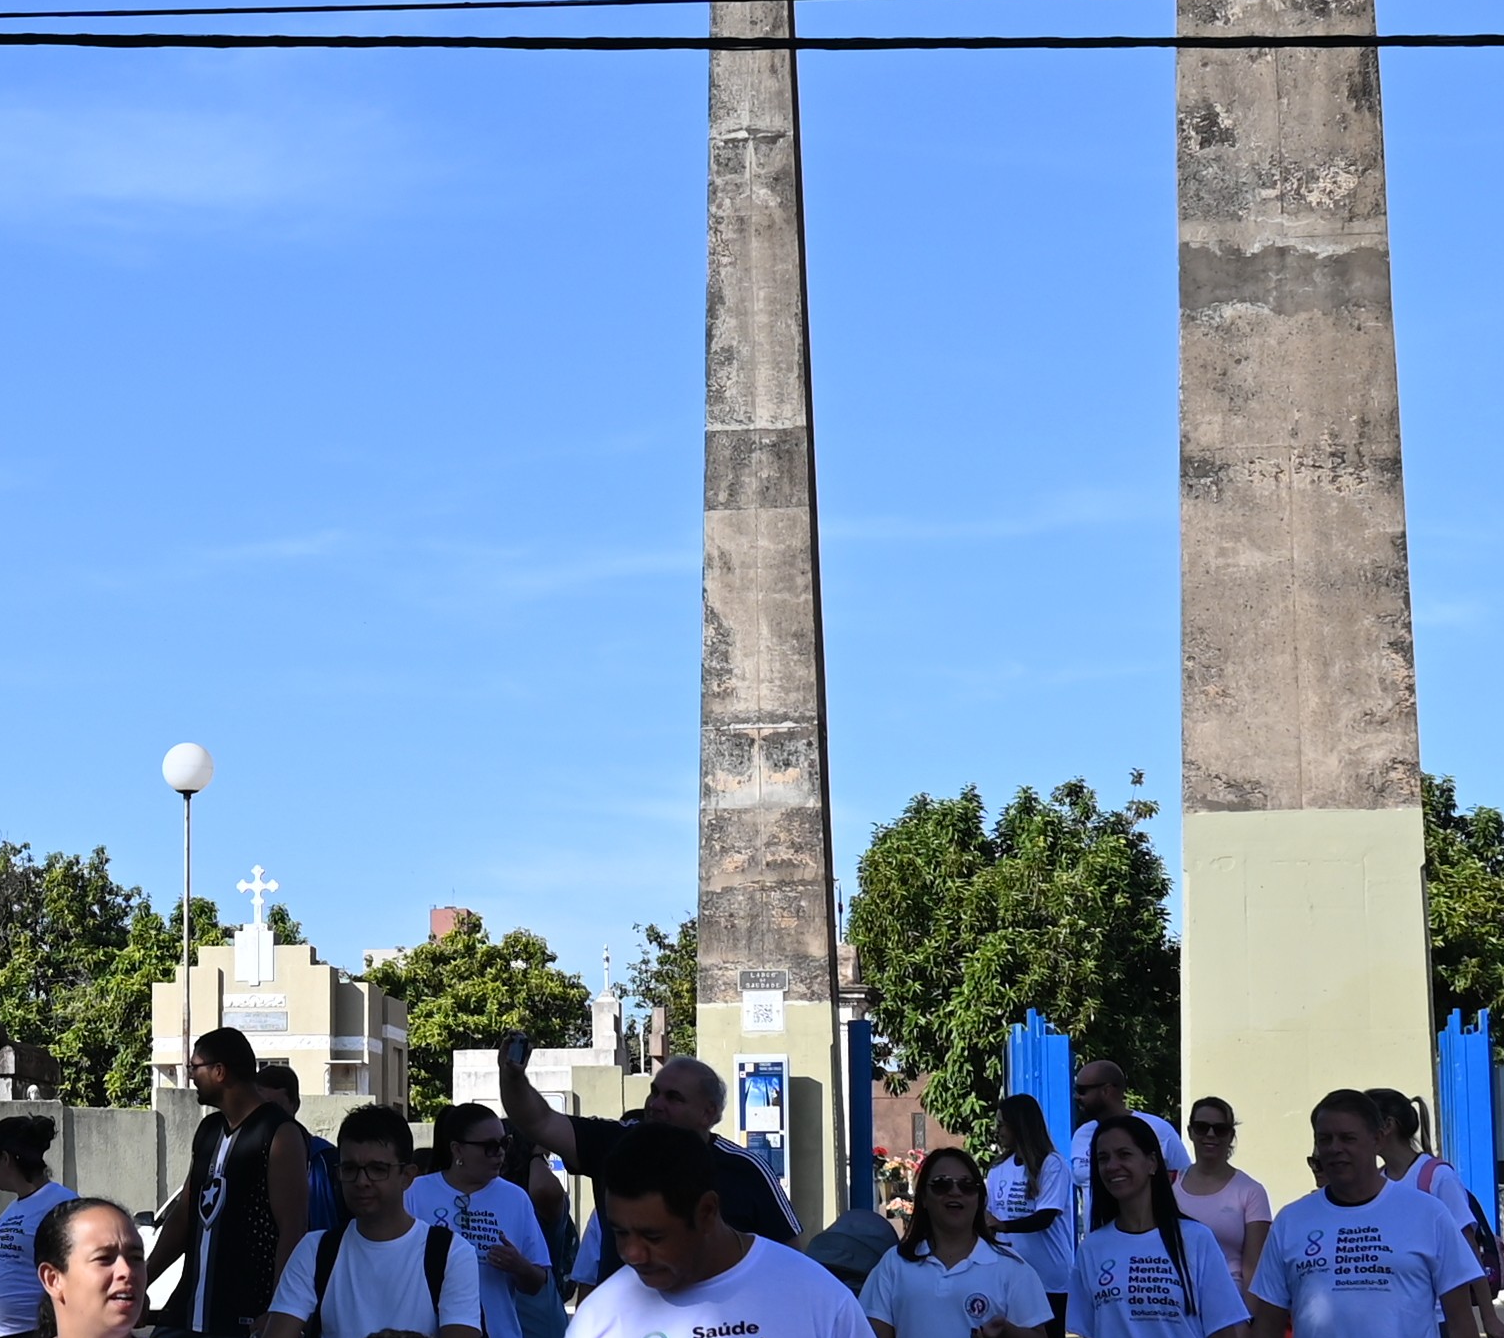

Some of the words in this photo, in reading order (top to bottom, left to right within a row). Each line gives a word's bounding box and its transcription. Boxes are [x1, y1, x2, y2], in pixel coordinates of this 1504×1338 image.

[1338, 1226, 1379, 1235] Saúde
[462, 1232, 497, 1243] Direito
[1337, 1234, 1381, 1244] Mental
[1336, 1244, 1393, 1254] Materna,
[1129, 1255, 1170, 1265] Saúde
[1296, 1257, 1327, 1270] MAIO
[1335, 1253, 1379, 1264] Direito
[1128, 1266, 1173, 1275] Mental
[1334, 1266, 1351, 1275] de
[1354, 1264, 1394, 1275] todas.
[1128, 1285, 1170, 1294] Direito
[1128, 1295, 1144, 1305] de
